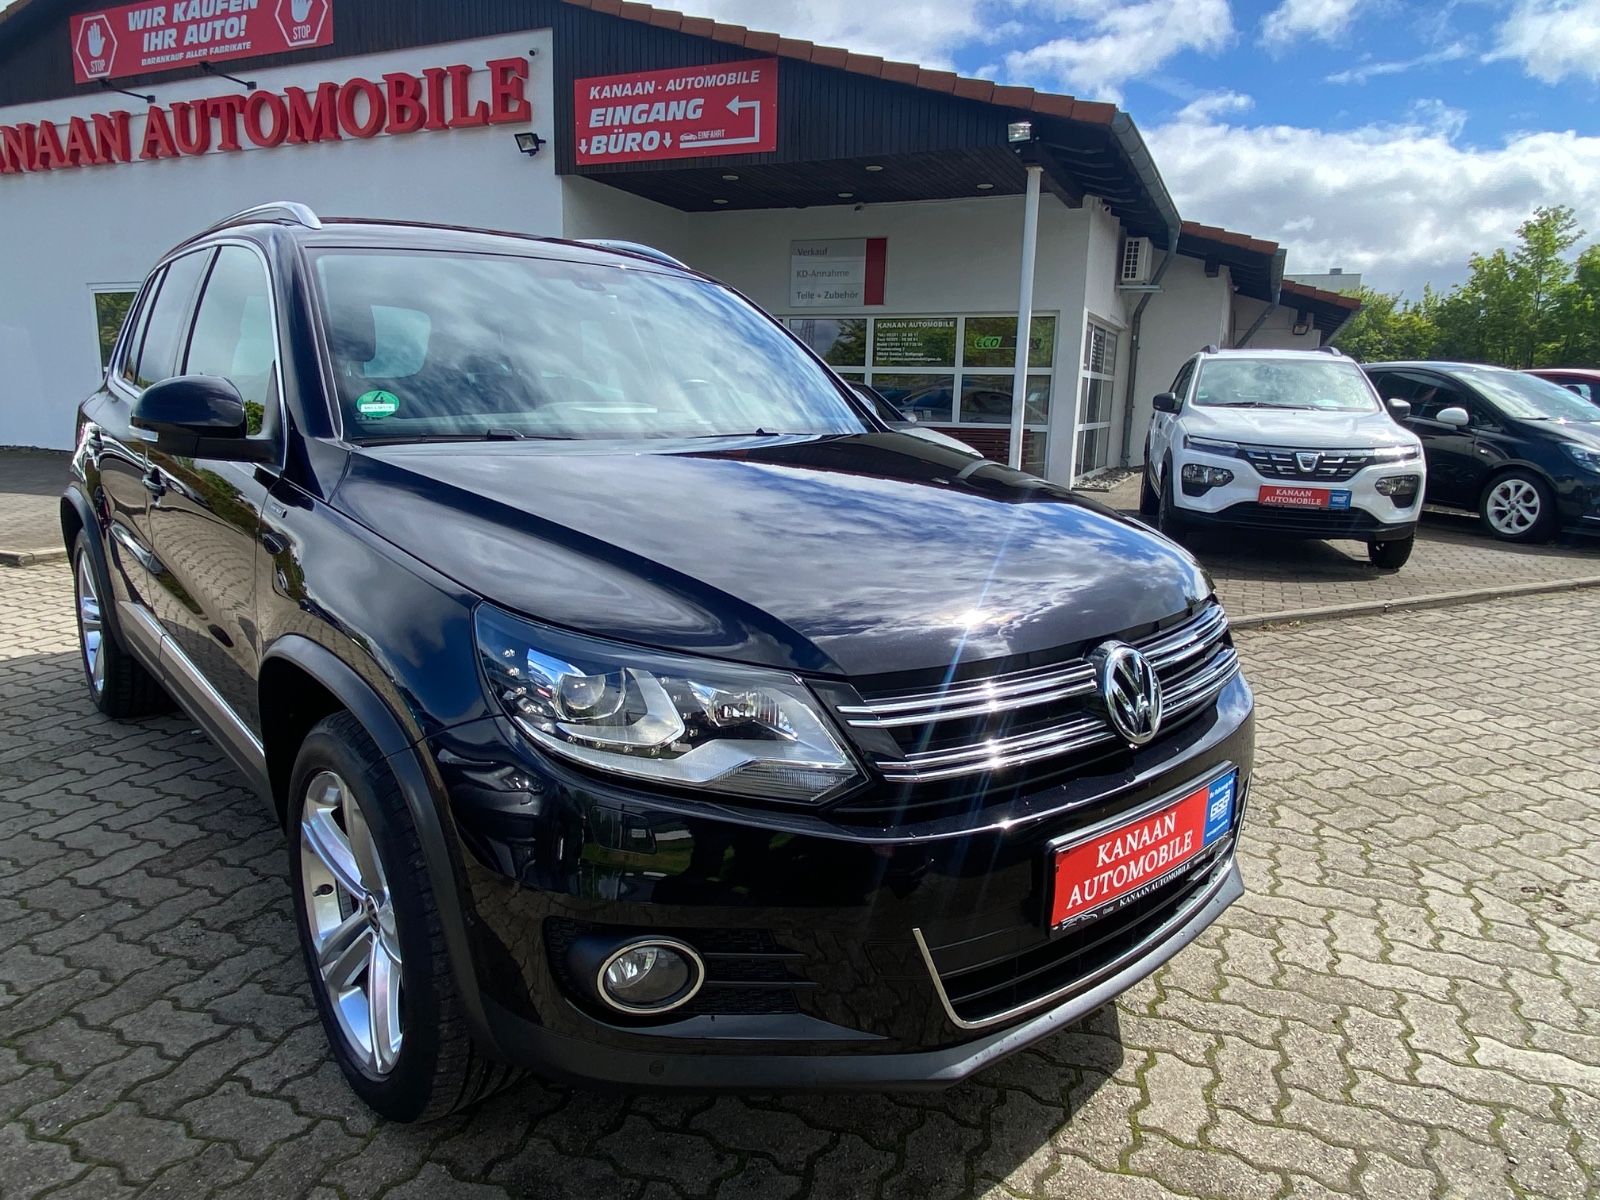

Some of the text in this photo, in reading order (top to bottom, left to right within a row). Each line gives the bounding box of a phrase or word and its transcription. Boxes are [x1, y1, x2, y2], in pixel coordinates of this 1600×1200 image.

[128, 6, 166, 31] WIR
[143, 14, 247, 52] IHR AUTO!
[292, 25, 311, 41] STOP
[186, 48, 208, 59] ALLER
[210, 41, 252, 55] FABRIKATE
[90, 60, 106, 73] STOP
[590, 81, 655, 100] KANAAN
[665, 70, 761, 92] AUTOMOBILE
[0, 57, 532, 173] NAAN AUTOMOBILE
[589, 98, 704, 128] EINGANG
[590, 129, 660, 155] BÜRO
[697, 129, 725, 140] EINFAHRT
[797, 247, 828, 256] Verkauf
[796, 269, 850, 279] KD-Annahme
[796, 290, 815, 300] Teile
[824, 290, 859, 300] Zubehör
[877, 320, 955, 329] KANAAN AUTOMOBILE
[373, 391, 385, 404] 4
[1264, 495, 1322, 505] AUTOMOBILE
[1275, 488, 1313, 497] KANAAN
[1096, 812, 1177, 868] KANAAN
[1066, 830, 1193, 910] AUTOMOBILE
[1119, 862, 1191, 907] KANAAN AUTOMOBILE
